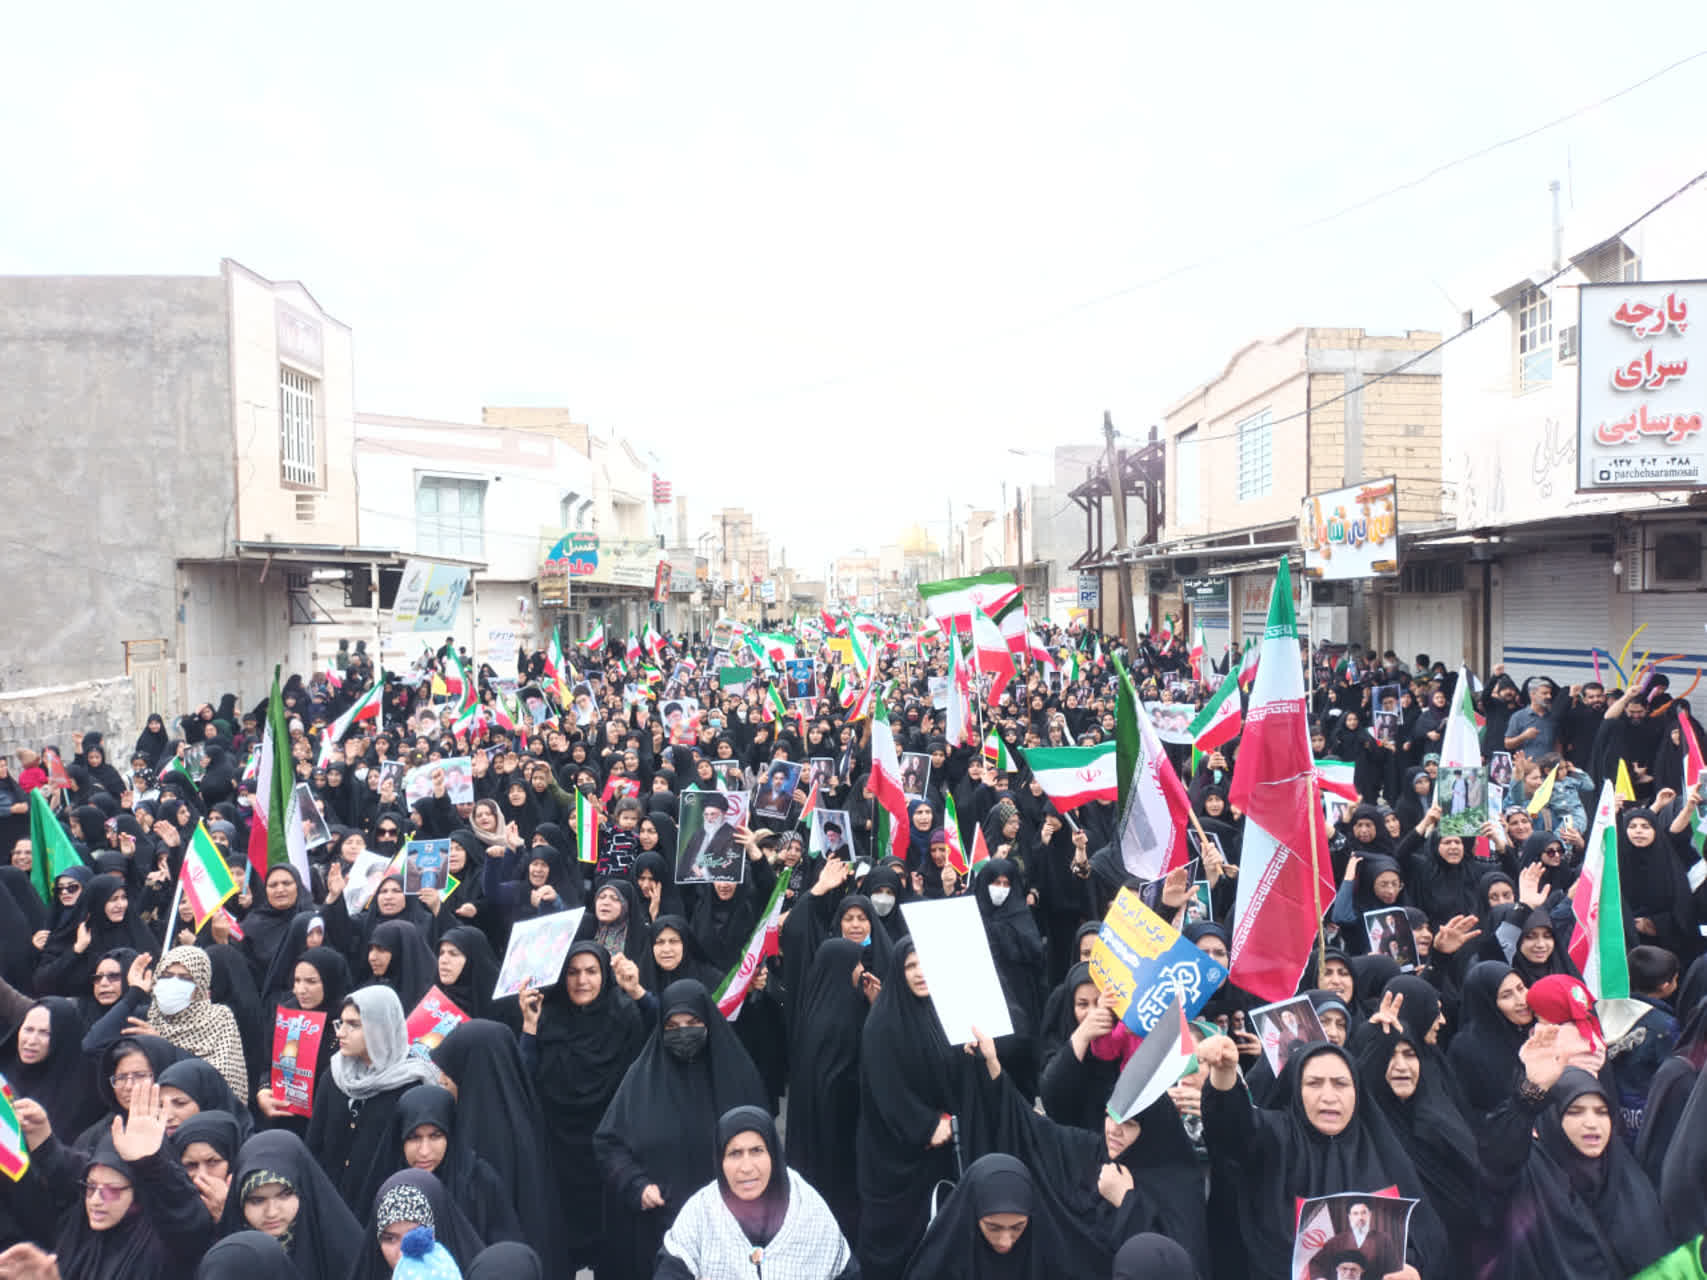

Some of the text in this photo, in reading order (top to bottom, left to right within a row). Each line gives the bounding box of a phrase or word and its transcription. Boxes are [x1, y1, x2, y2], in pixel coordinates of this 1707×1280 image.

[1614, 293, 1689, 336] پارچه
[1614, 349, 1689, 388] سرای
[1597, 404, 1703, 443] موسایی
